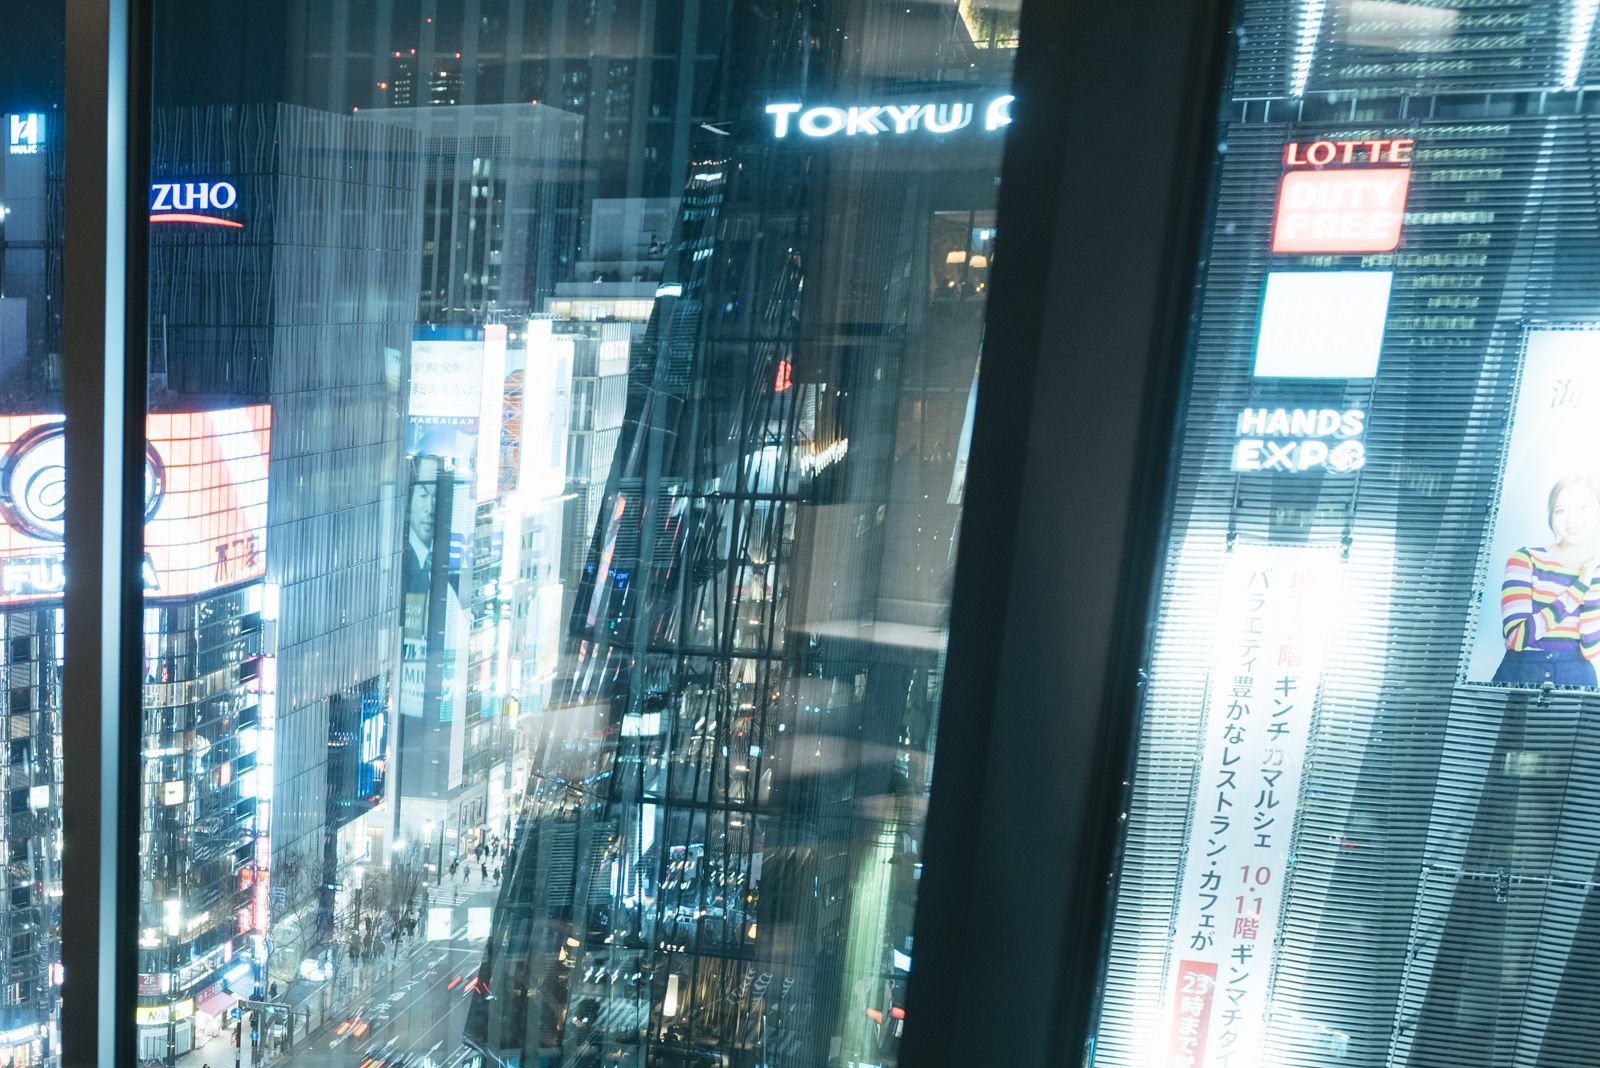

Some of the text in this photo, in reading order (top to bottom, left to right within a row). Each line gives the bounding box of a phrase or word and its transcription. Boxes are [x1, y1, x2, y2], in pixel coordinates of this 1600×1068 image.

[765, 102, 964, 138] TOKYU
[1286, 138, 1414, 166] LOTTE
[151, 182, 237, 210] ZUHO
[1288, 179, 1399, 209] DUTY
[1284, 211, 1392, 240] FREE
[409, 416, 475, 425] HAKKAISAN
[1241, 407, 1365, 437] HANDS
